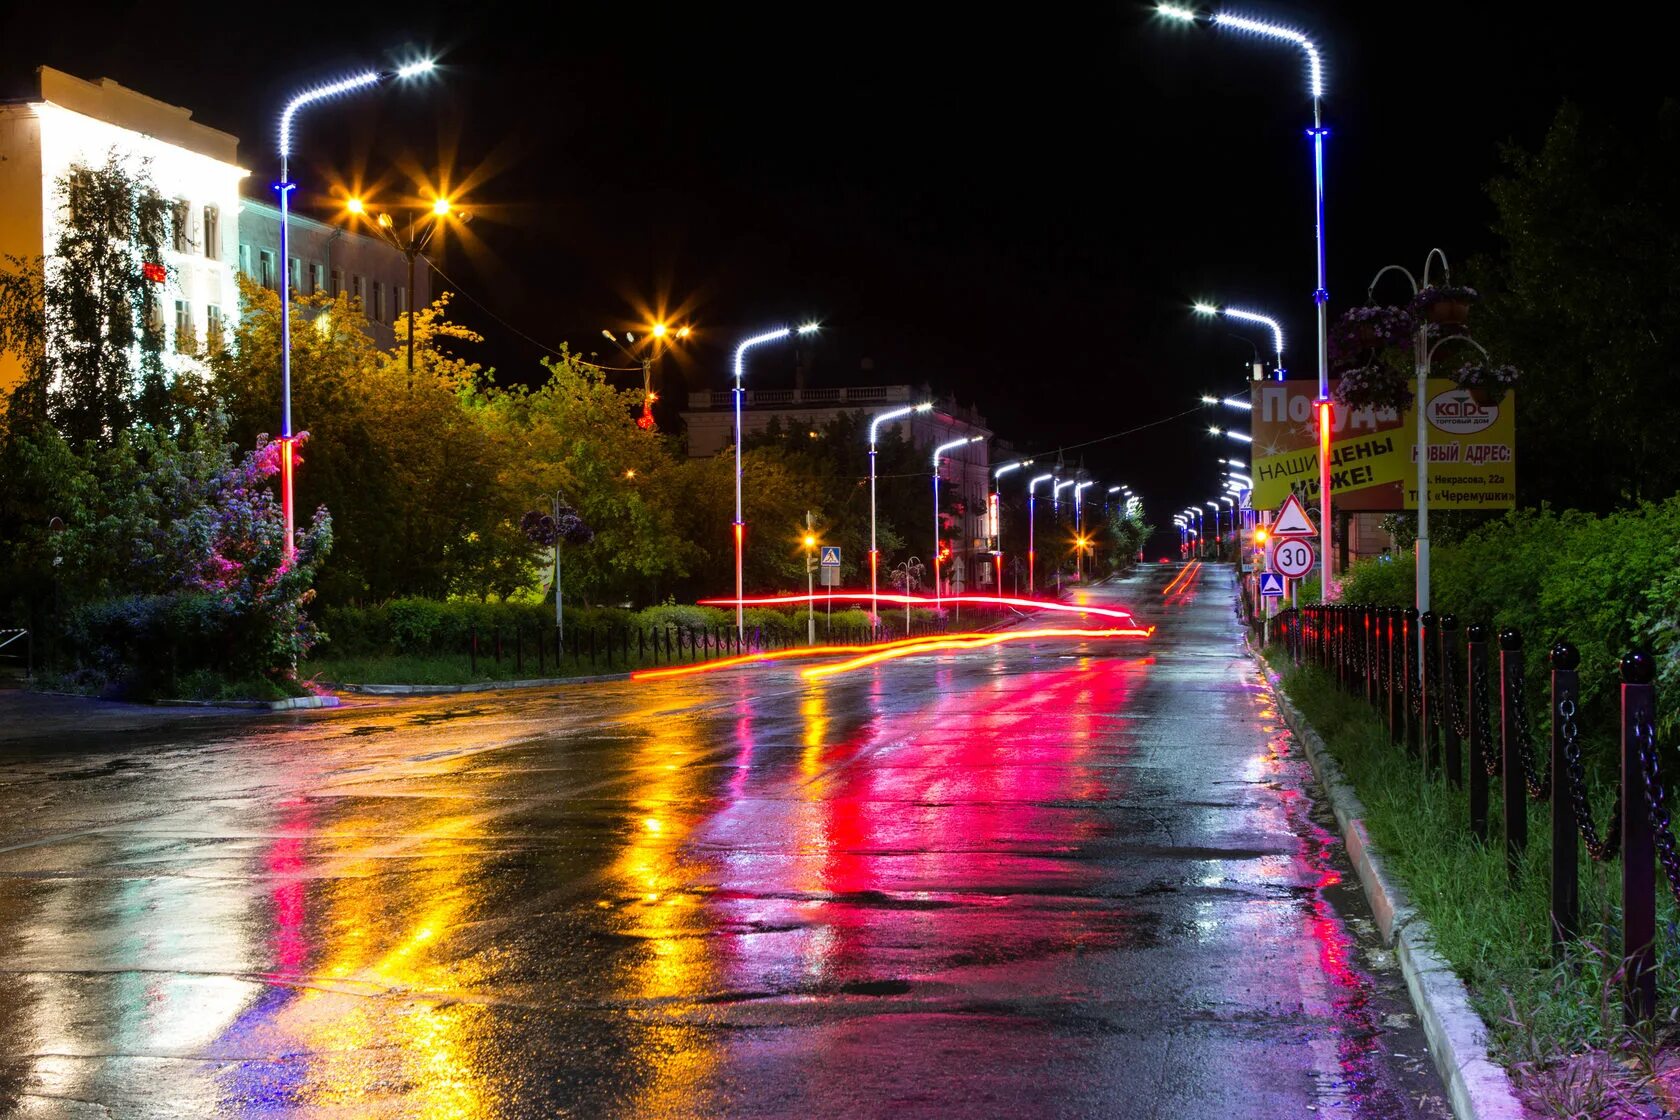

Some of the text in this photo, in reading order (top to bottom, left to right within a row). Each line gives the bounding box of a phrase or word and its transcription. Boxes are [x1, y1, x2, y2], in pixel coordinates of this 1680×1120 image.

[1412, 443, 1511, 465] НВЫЙ АДРЕС:
[1259, 454, 1320, 481] НАШИ
[1434, 475, 1487, 486] Некрасова,
[1488, 474, 1505, 484] 22а
[1434, 490, 1515, 504] «Черемушки»
[1282, 548, 1306, 567] 30
